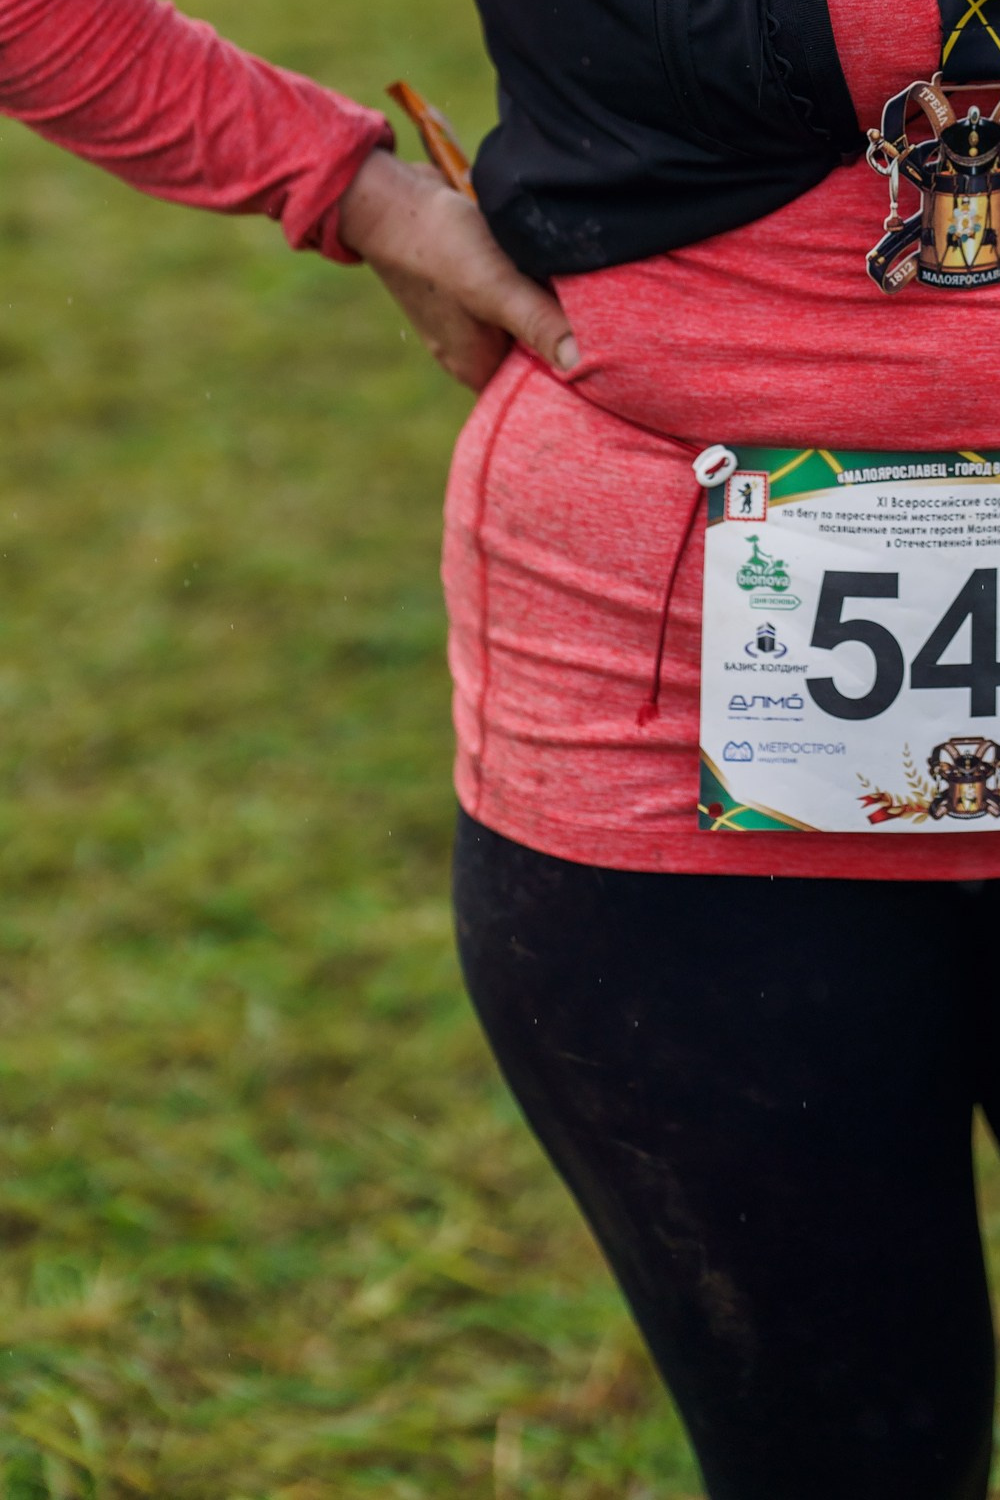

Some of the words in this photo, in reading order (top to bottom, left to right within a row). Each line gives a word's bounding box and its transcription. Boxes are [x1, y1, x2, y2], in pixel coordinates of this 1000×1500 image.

[919, 87, 949, 127] ТРЕЙЛ
[888, 262, 915, 287] 1812
[955, 462, 992, 477] ГОРОД
[891, 495, 980, 511] Всероссийские
[797, 508, 818, 520] бегу
[820, 511, 833, 520] по
[911, 512, 966, 522] местности
[819, 524, 887, 535] посвященные
[890, 526, 927, 535] памяти
[930, 525, 963, 536] героев
[894, 536, 972, 549] Отечественной
[738, 570, 791, 587] bionova
[724, 662, 757, 672] БАЗИС
[760, 663, 808, 673] ХОЛДИНГ
[757, 741, 846, 756] МЕТРОСТРОЙ
